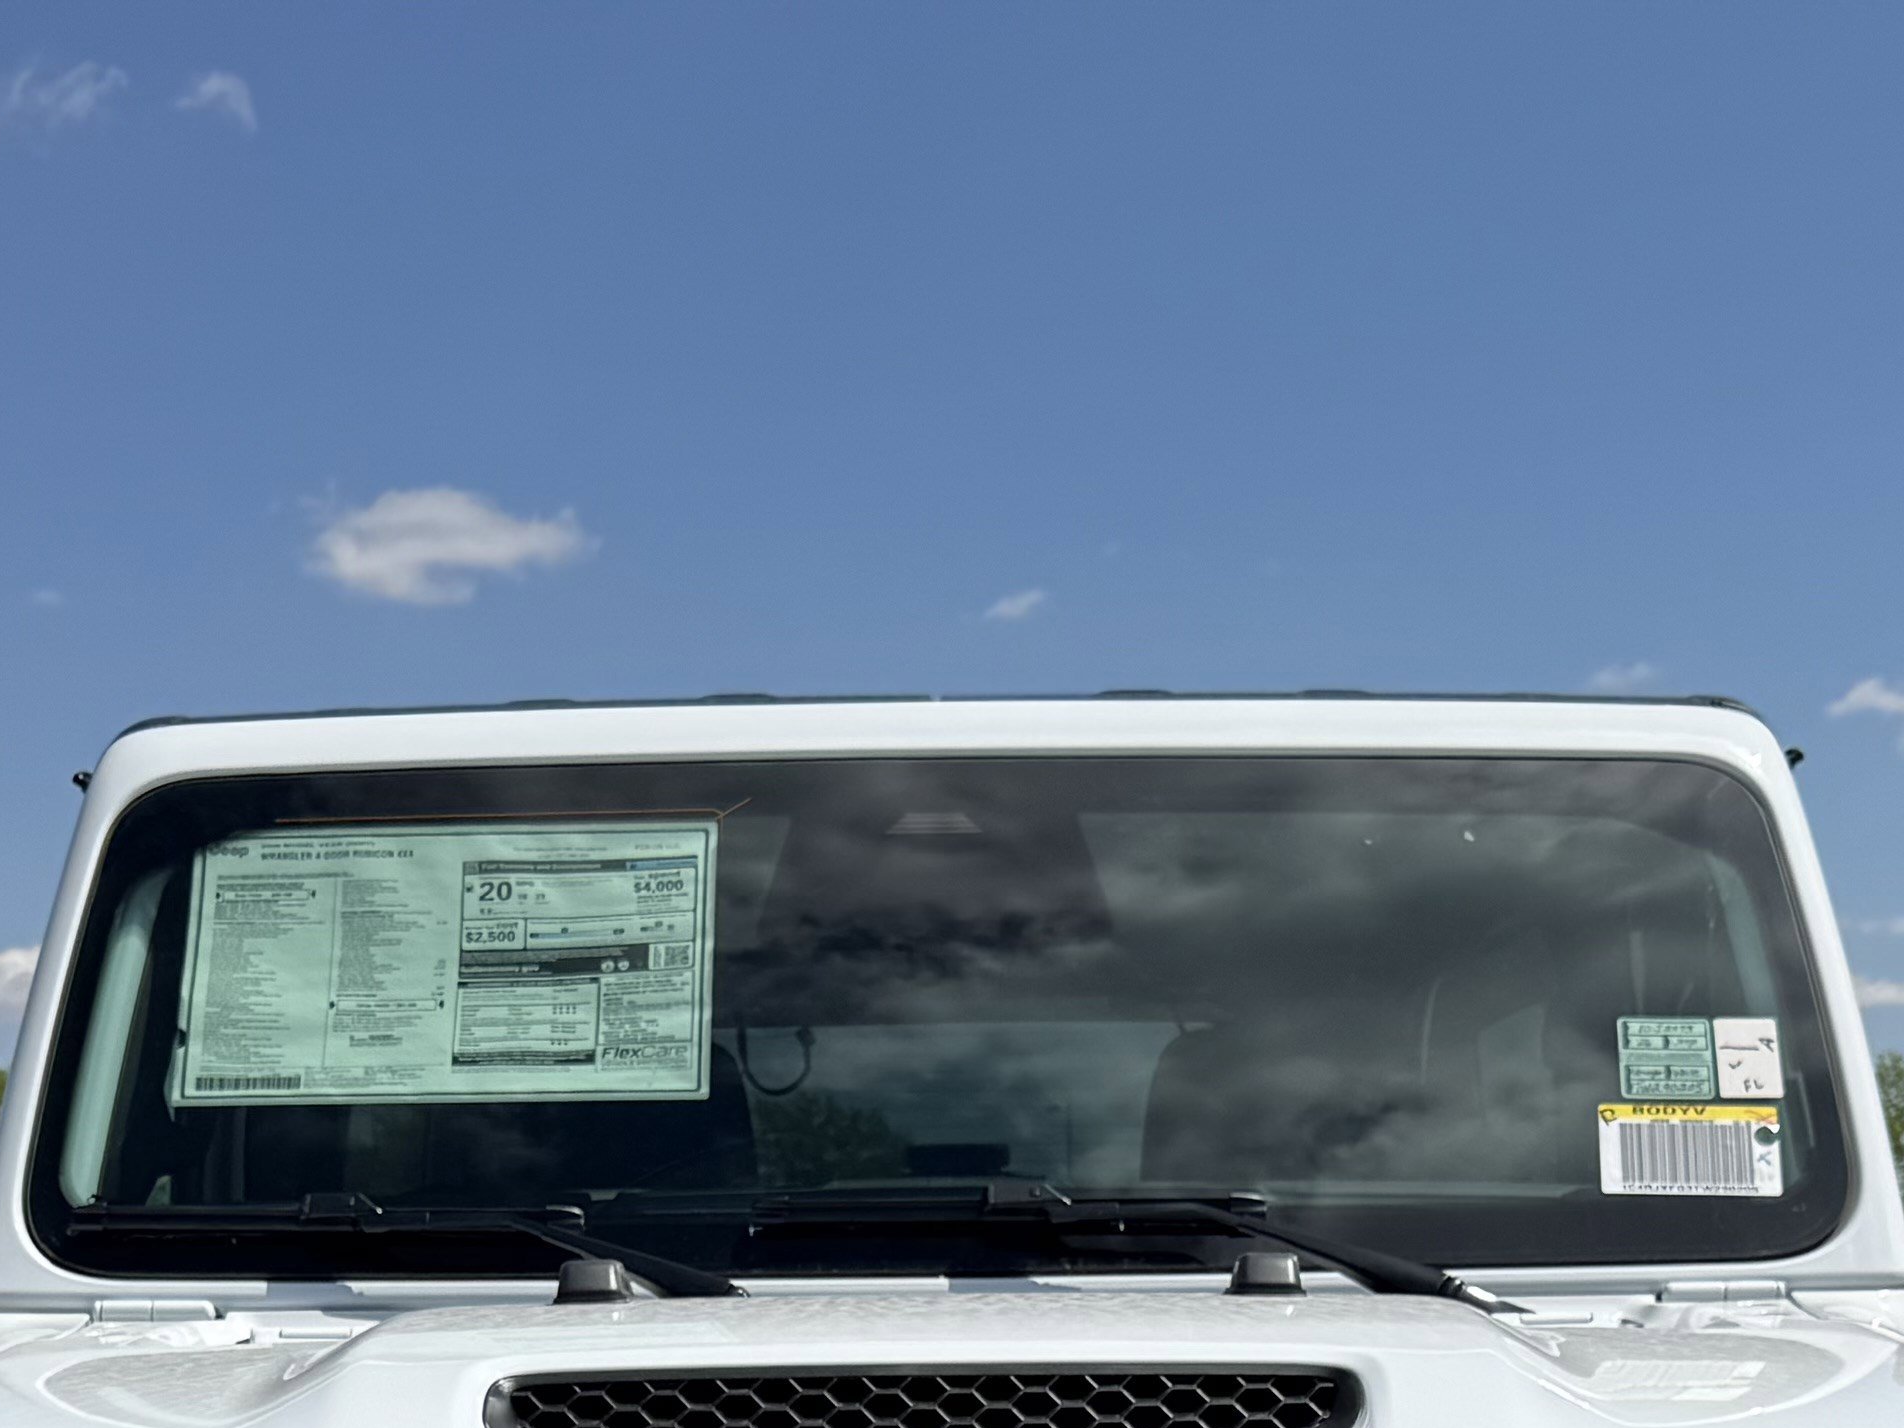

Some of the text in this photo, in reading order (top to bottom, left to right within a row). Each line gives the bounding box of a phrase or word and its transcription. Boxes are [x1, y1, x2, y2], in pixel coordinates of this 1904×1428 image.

[478, 880, 513, 902] 20
[633, 879, 684, 894] $4,000
[465, 930, 516, 944] $2,500
